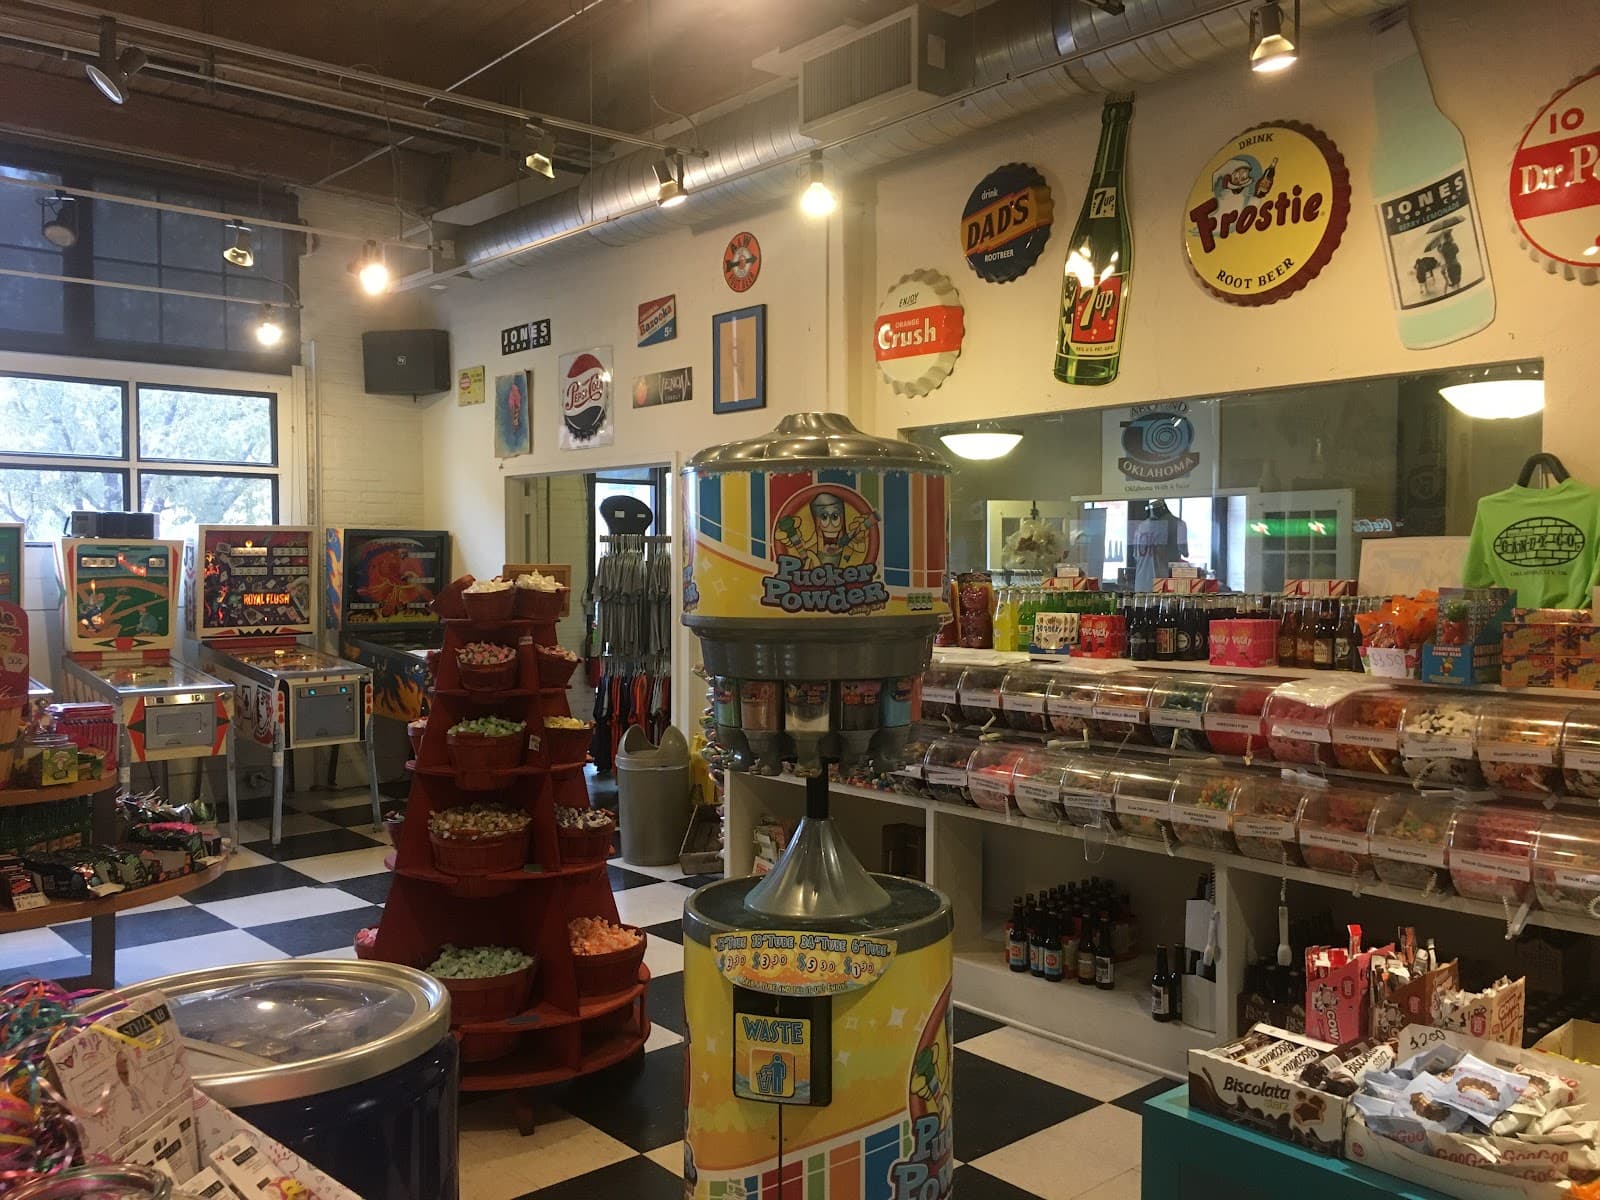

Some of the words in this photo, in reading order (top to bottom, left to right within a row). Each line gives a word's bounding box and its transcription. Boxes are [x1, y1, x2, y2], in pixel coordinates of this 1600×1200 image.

[1549, 107, 1585, 135] 10
[1238, 132, 1274, 151] DRINK
[981, 187, 999, 201] drink
[1387, 176, 1464, 219] JONES
[967, 193, 1028, 251] DAD'S
[1190, 185, 1323, 254] Frostie
[1216, 270, 1254, 289] ROOT
[1258, 257, 1296, 288] BEER
[899, 292, 919, 308] ENJOY
[504, 322, 548, 346] JONES
[640, 304, 673, 336] Bazooka
[878, 317, 936, 350] Crush
[1123, 456, 1194, 478] OKLAHOMA
[778, 554, 875, 587] Pucker
[243, 593, 265, 606] ROYAL
[266, 592, 290, 605] FLUSH
[742, 1016, 804, 1045] WASTE
[1326, 1009, 1341, 1041] COW
[1223, 1076, 1291, 1101] Biscolata
